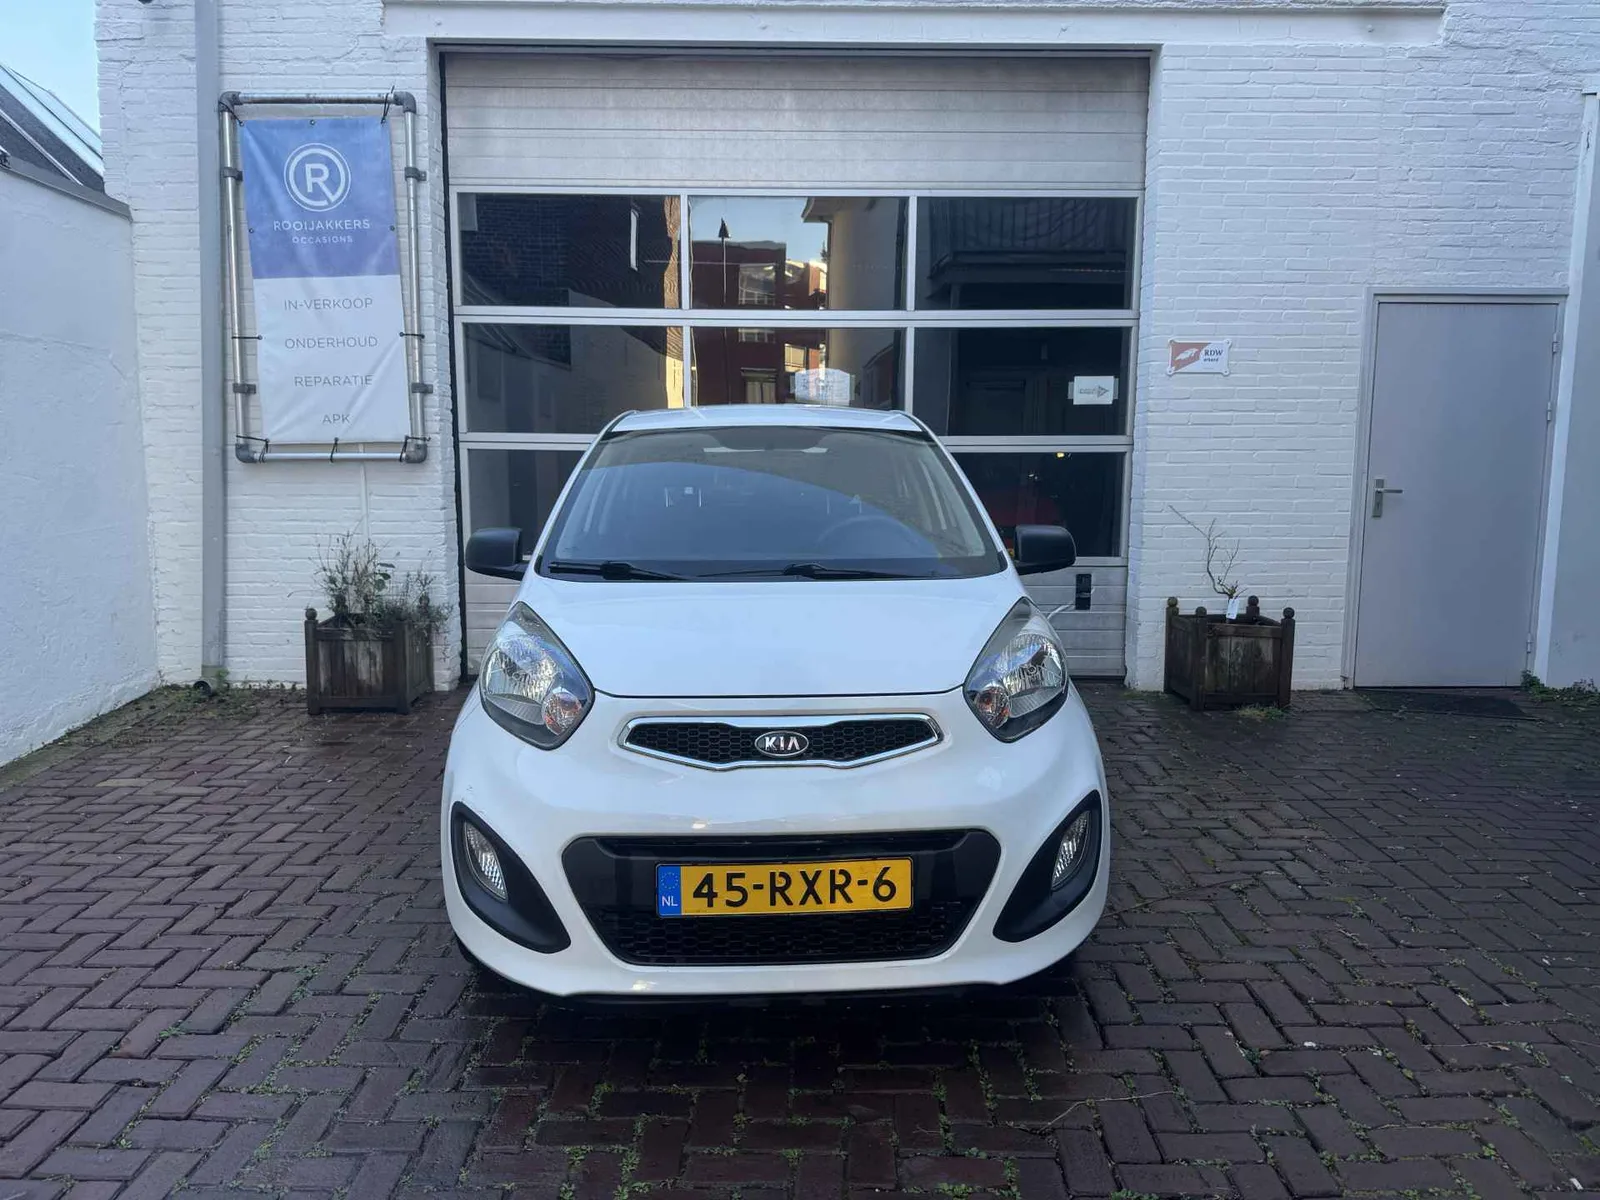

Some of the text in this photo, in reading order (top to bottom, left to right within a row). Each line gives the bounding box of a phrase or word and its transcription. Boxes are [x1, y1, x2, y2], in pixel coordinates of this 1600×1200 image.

[273, 219, 370, 232] ROOIJAKKERS
[291, 235, 353, 244] OCCASIONS
[284, 298, 373, 311] IN-VERKOOP
[285, 336, 378, 349] ONDERHOUD
[294, 374, 373, 387] REPARATIE
[322, 413, 350, 425] APK
[764, 736, 800, 751] KIA
[692, 866, 897, 908] 45-RXR-6
[661, 896, 678, 907] NL
